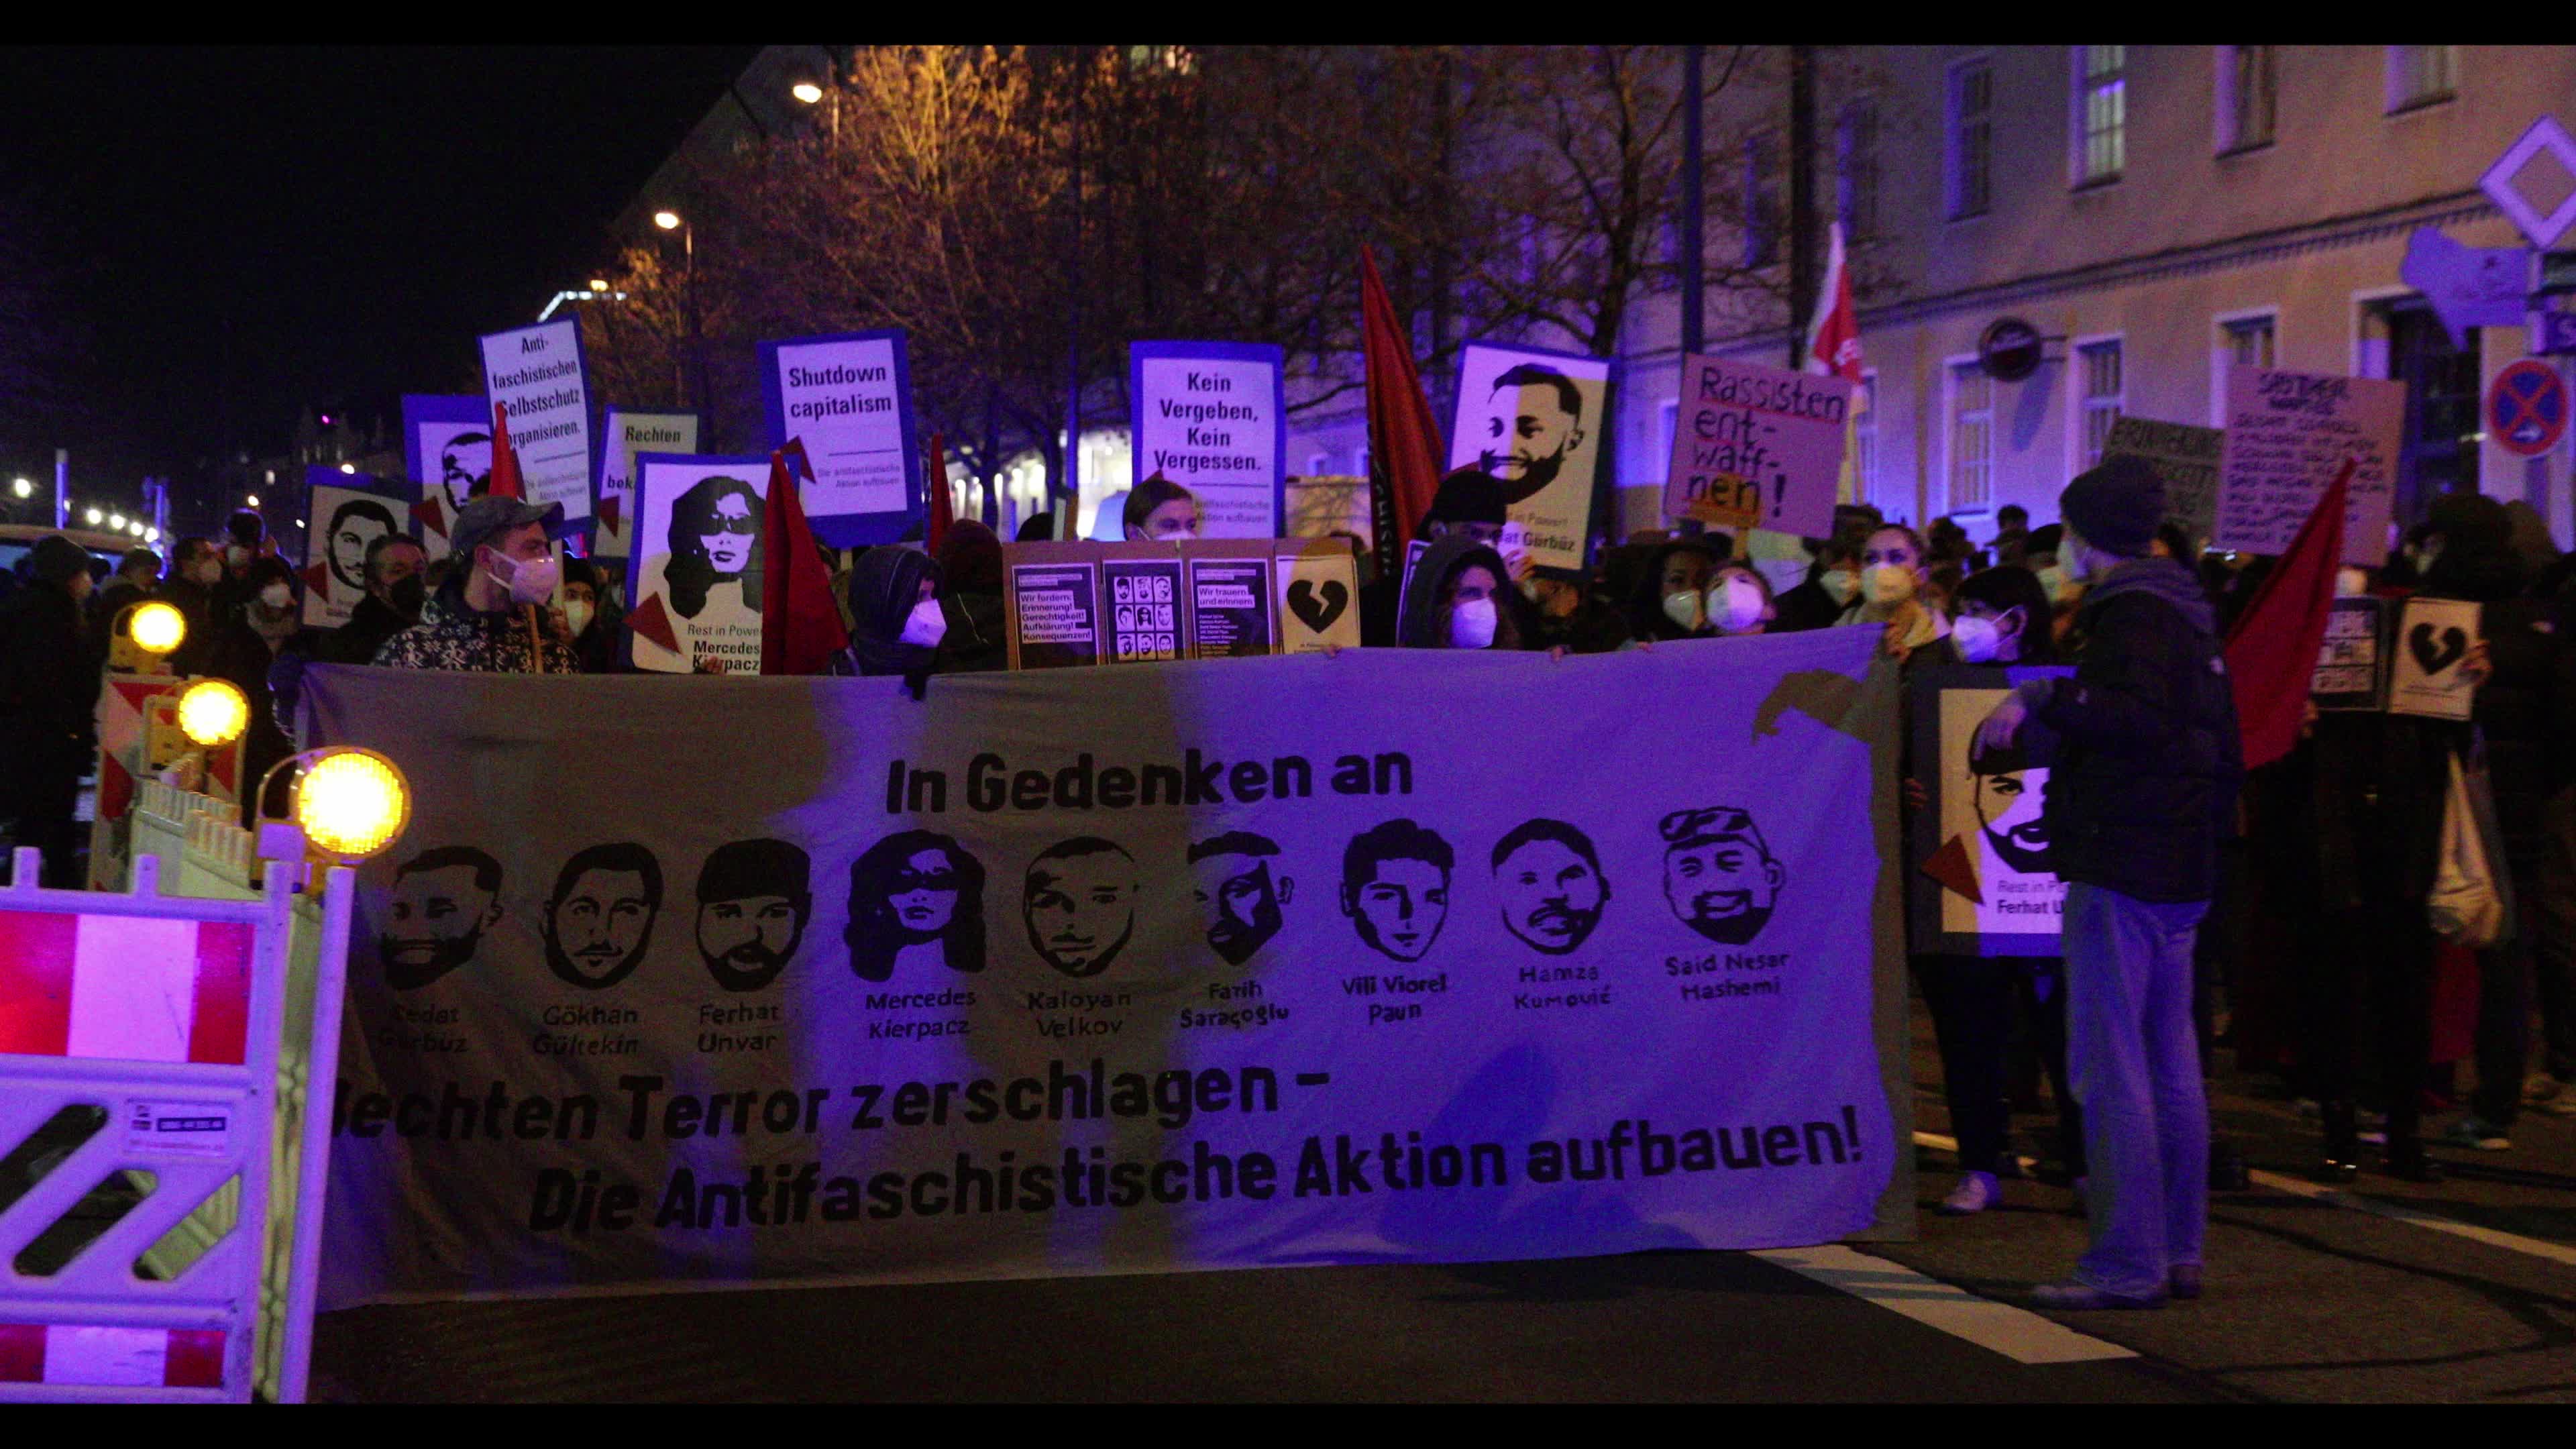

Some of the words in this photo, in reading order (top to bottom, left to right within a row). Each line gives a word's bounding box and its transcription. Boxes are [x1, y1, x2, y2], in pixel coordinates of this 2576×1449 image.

[493, 360, 578, 390] faschistischen
[788, 364, 886, 387] Shutdown
[1187, 372, 1231, 392] Kein
[1699, 366, 1845, 424] Rassisten
[790, 394, 892, 422] capitalism
[1160, 399, 1258, 424] Vergeben,
[625, 425, 681, 442] Rechten
[1187, 427, 1230, 446] Kein
[1154, 449, 1261, 474] Vergessen.
[1021, 594, 1036, 602] Wir
[1199, 588, 1214, 596] Wir
[1022, 603, 1073, 612] Erinnerung!
[1022, 612, 1084, 621] Gerechtigkeit!
[688, 624, 712, 635] Rest
[715, 626, 725, 636] in
[1023, 621, 1073, 631] Aufklärung!
[1024, 631, 1091, 641] Konsequenzen!
[694, 641, 761, 655] Mercedes
[886, 759, 946, 814] In
[966, 749, 1313, 813] Gedenken
[1330, 751, 1413, 796] an
[1997, 899, 2048, 914] Ferhat
[1519, 966, 1599, 983] Hamza
[1665, 954, 1717, 976] Said
[1725, 954, 1790, 971] Nesar
[1383, 973, 1448, 994] Viorel
[1680, 976, 1780, 1001] Hashemi
[865, 987, 976, 1011] Mercedes
[1028, 989, 1132, 1012] Kaloyan
[543, 1004, 638, 1026] Gökhan
[699, 1003, 779, 1026] Ferhat
[1368, 1003, 1422, 1025] Paun
[869, 1018, 971, 1042] Kierpacz
[1036, 1016, 1124, 1039] Velkov
[532, 1033, 640, 1057] Gültekin
[698, 1032, 777, 1053] Unvar
[617, 1075, 830, 1140] Terror
[850, 1058, 1279, 1130] zerschlagen
[529, 1165, 642, 1234] Die
[653, 1140, 1277, 1230] Antifaschistische
[1293, 1131, 1508, 1198] Aktion
[1526, 1105, 1864, 1184] aufbauen!
